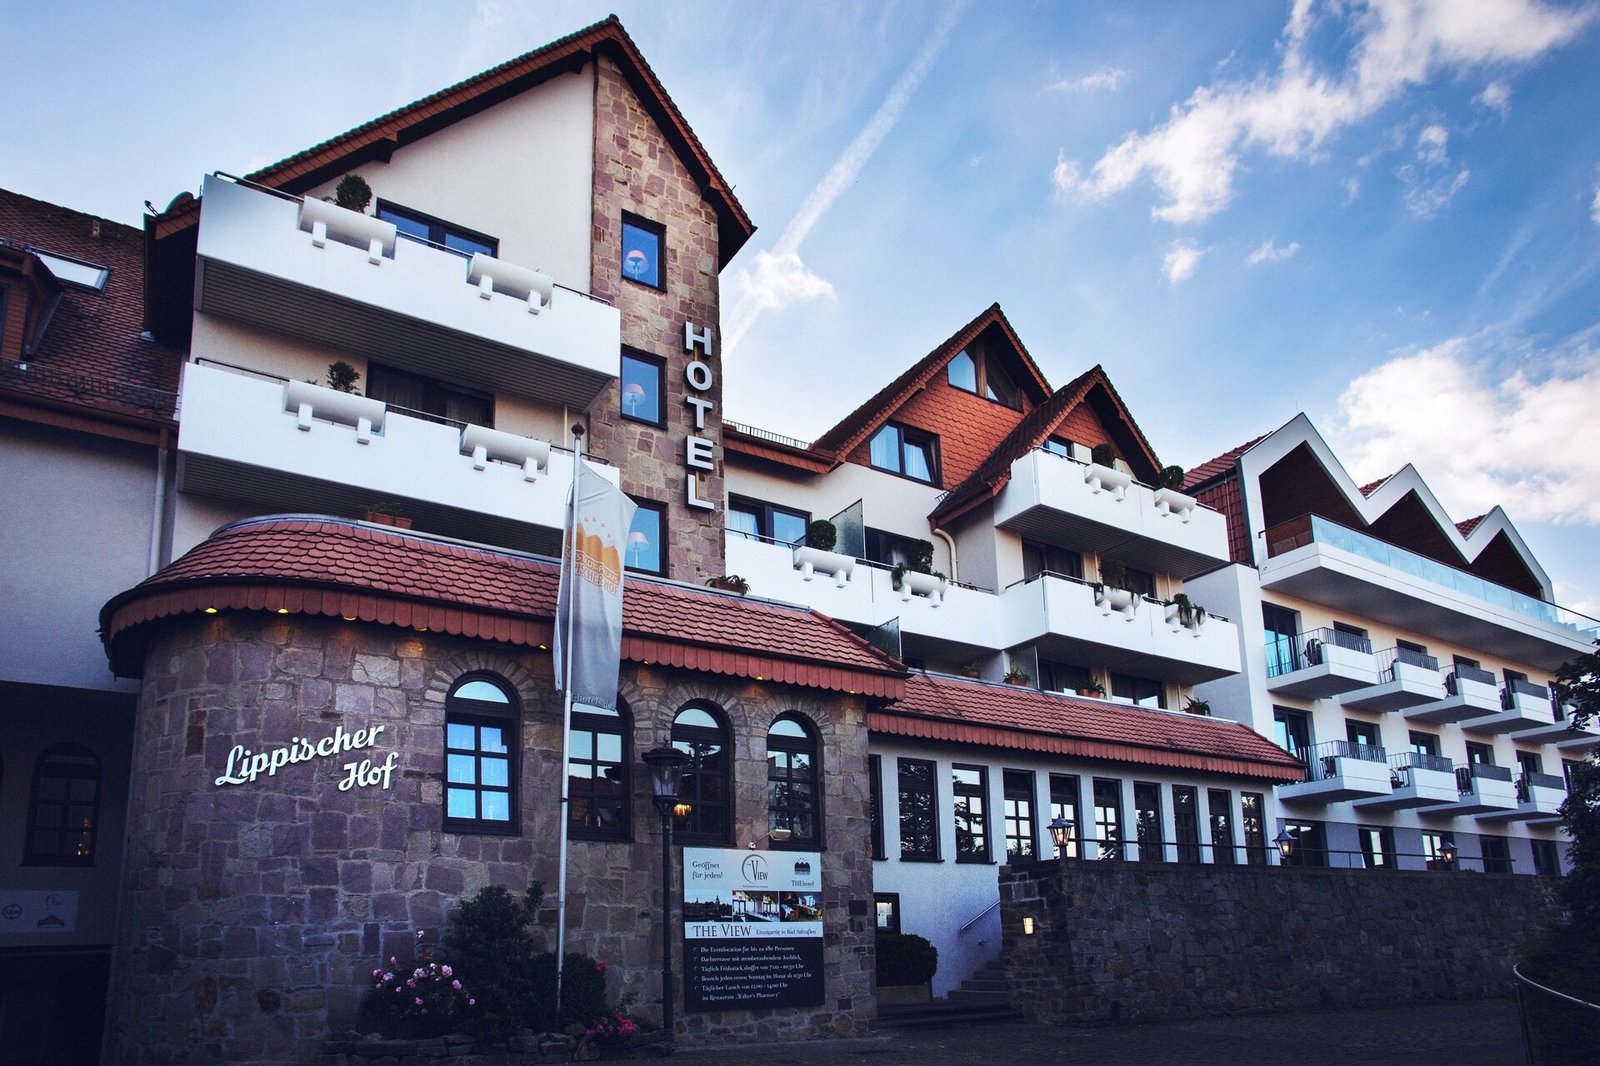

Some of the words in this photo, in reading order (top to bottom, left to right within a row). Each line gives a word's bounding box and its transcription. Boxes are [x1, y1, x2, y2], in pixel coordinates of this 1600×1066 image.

[684, 321, 714, 511] HOTEL
[214, 725, 385, 786] Lippischer
[338, 751, 400, 791] Hof
[692, 860, 720, 870] Geöffnet
[692, 871, 702, 880] für
[704, 871, 723, 880] jeden!
[693, 925, 717, 937] THE
[721, 923, 752, 937] VIEW
